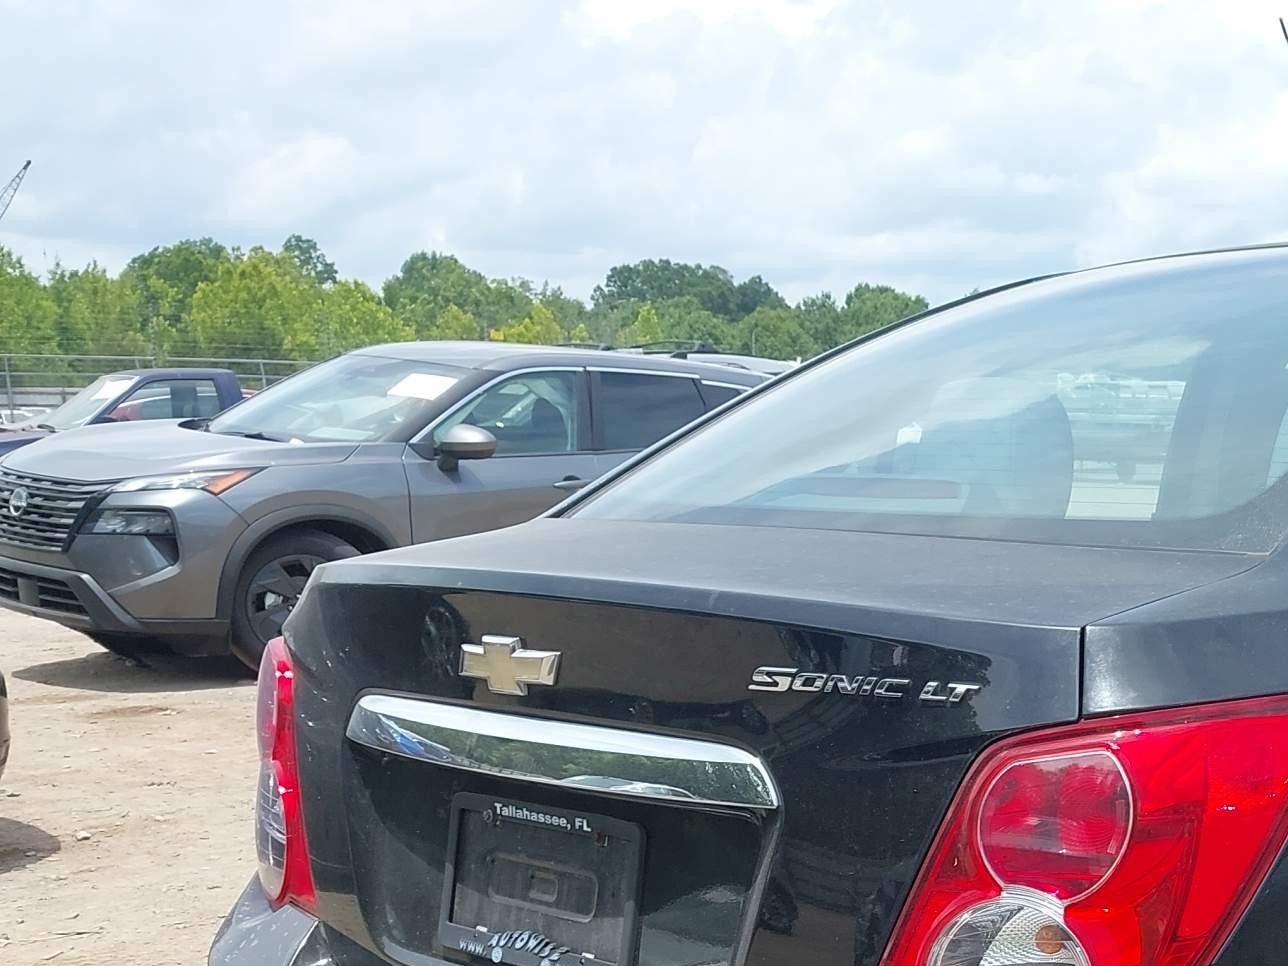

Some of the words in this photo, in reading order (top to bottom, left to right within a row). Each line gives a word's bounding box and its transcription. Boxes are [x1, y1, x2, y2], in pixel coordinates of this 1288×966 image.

[748, 666, 911, 697] SONIC
[919, 681, 981, 702] LT
[494, 803, 571, 831] Tallahassee,
[575, 819, 591, 832] FL
